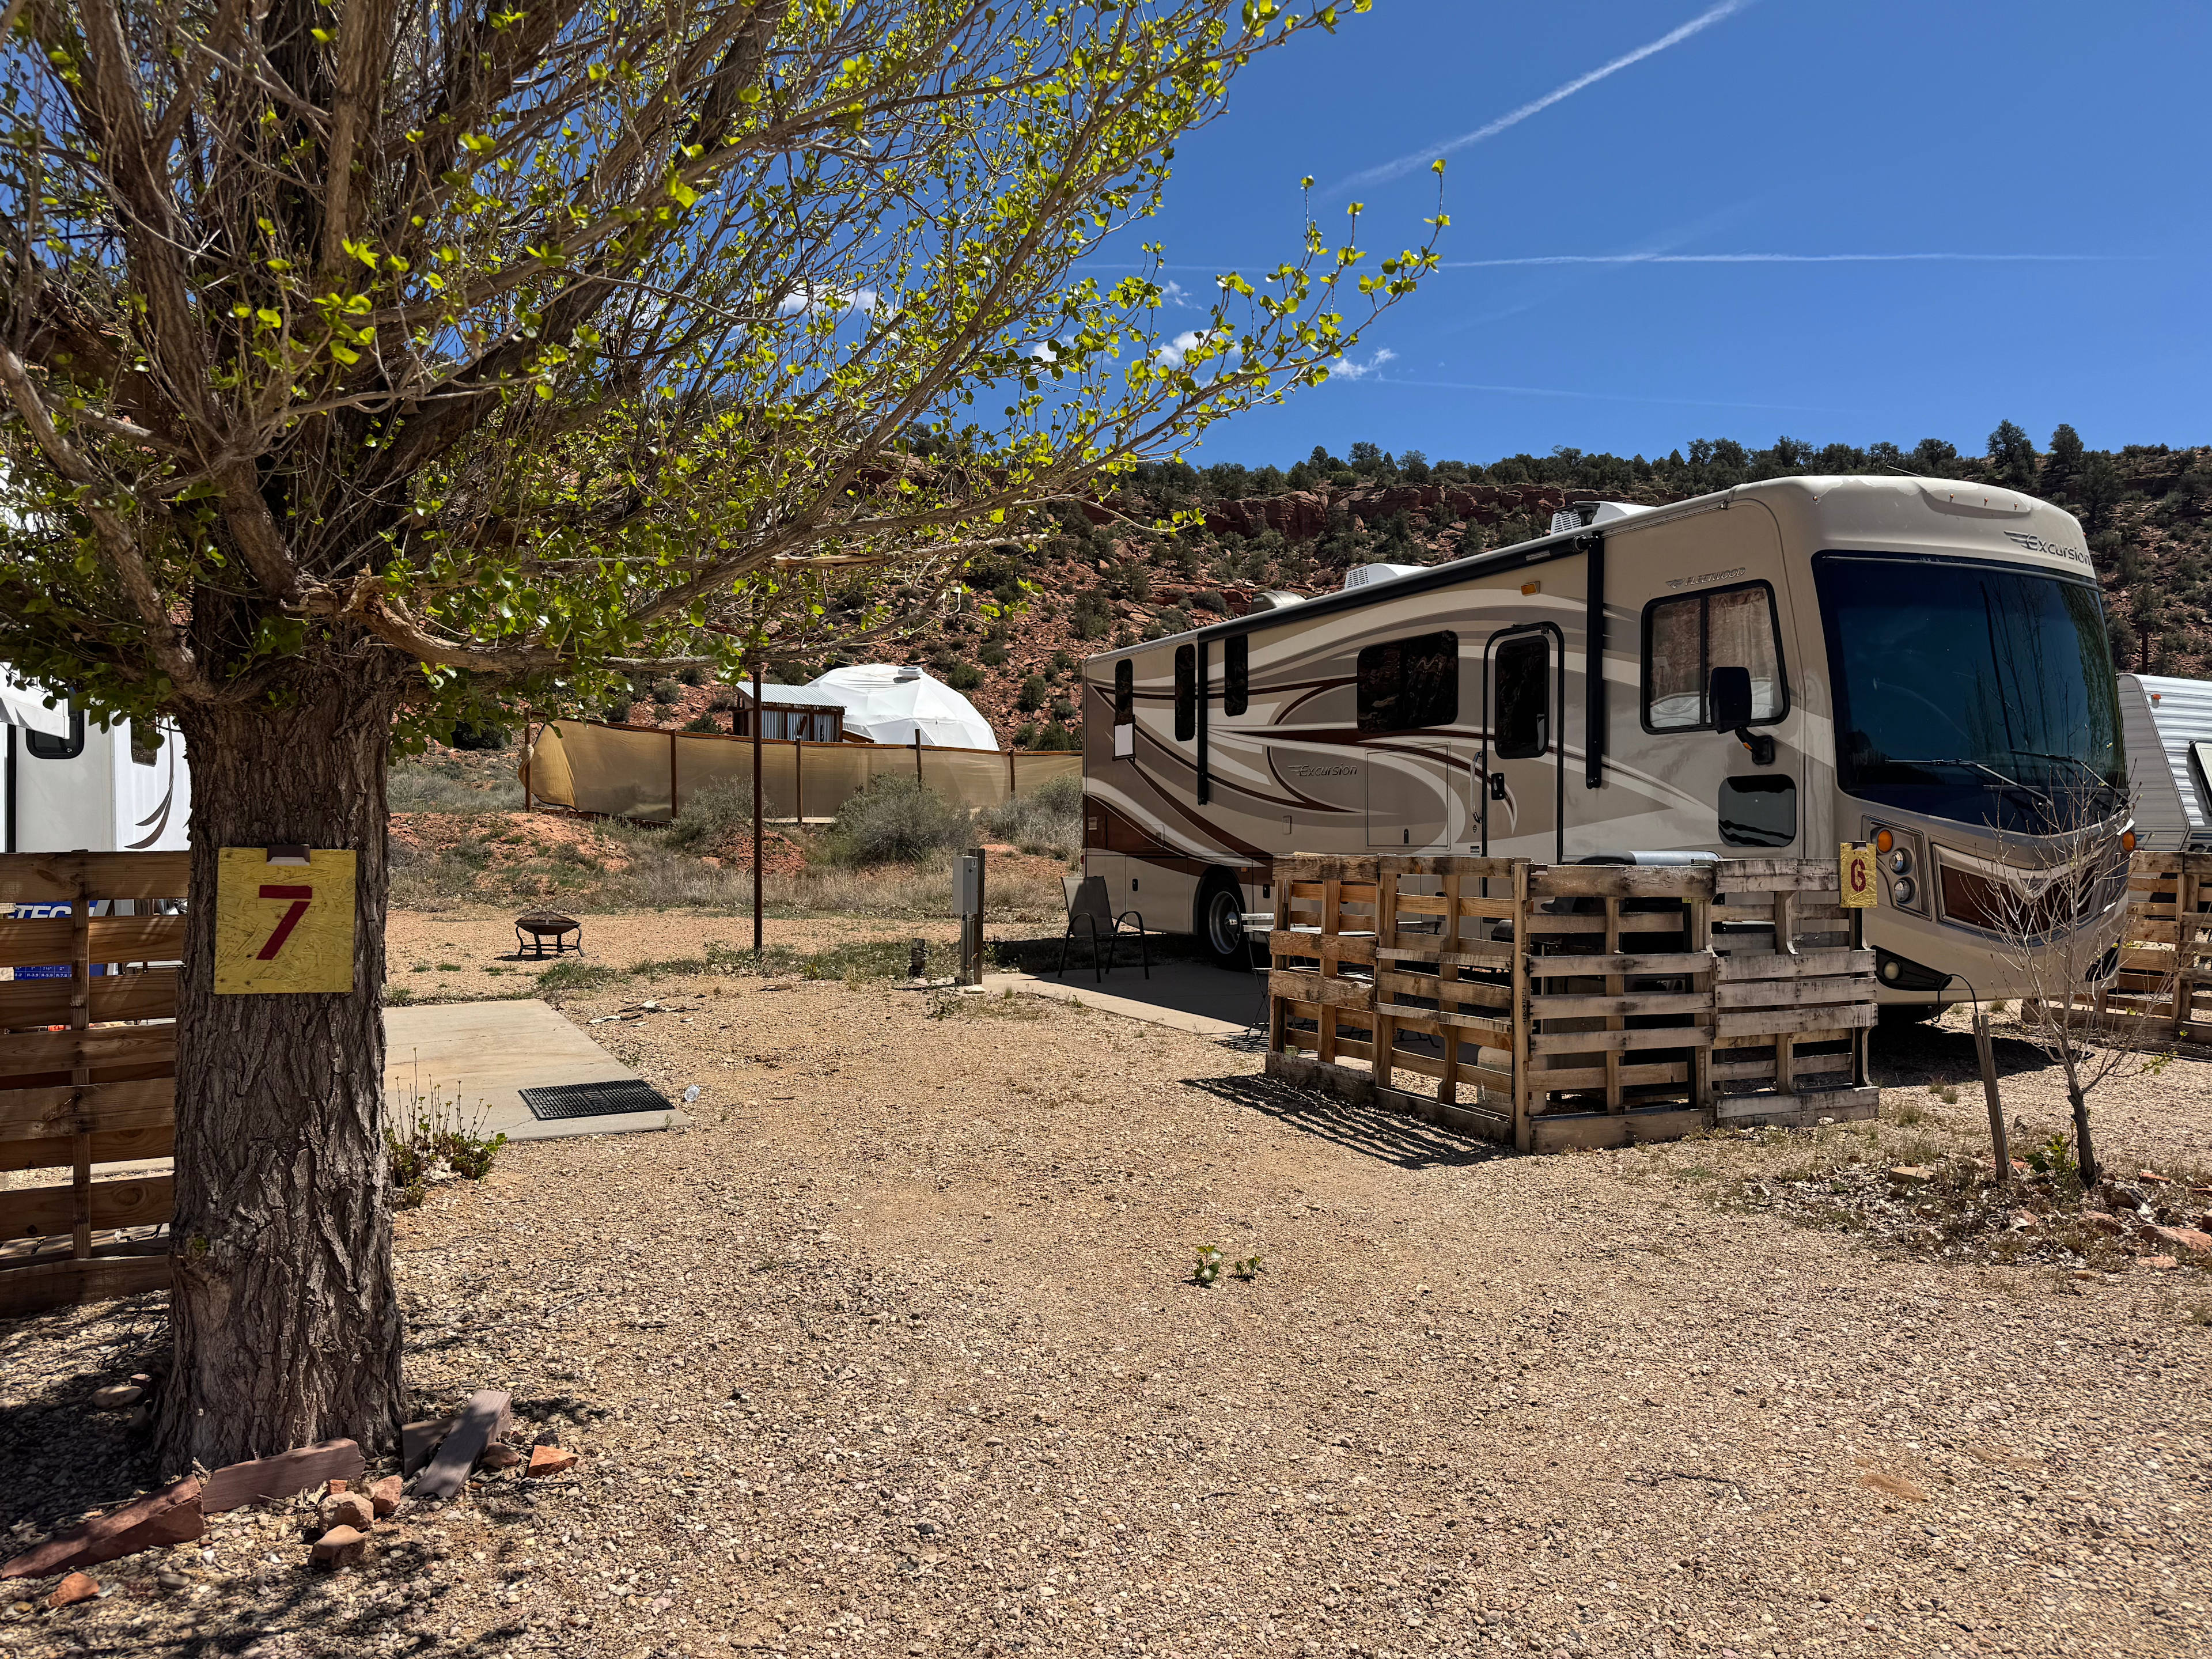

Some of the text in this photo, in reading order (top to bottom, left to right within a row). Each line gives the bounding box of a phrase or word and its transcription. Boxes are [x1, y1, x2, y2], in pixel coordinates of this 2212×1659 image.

[2026, 533, 2091, 566] Excursion
[1685, 567, 1746, 586] FLEETWOOD
[1299, 763, 1358, 777] Excursion
[1851, 858, 1866, 892] 6
[256, 885, 313, 960] 7
